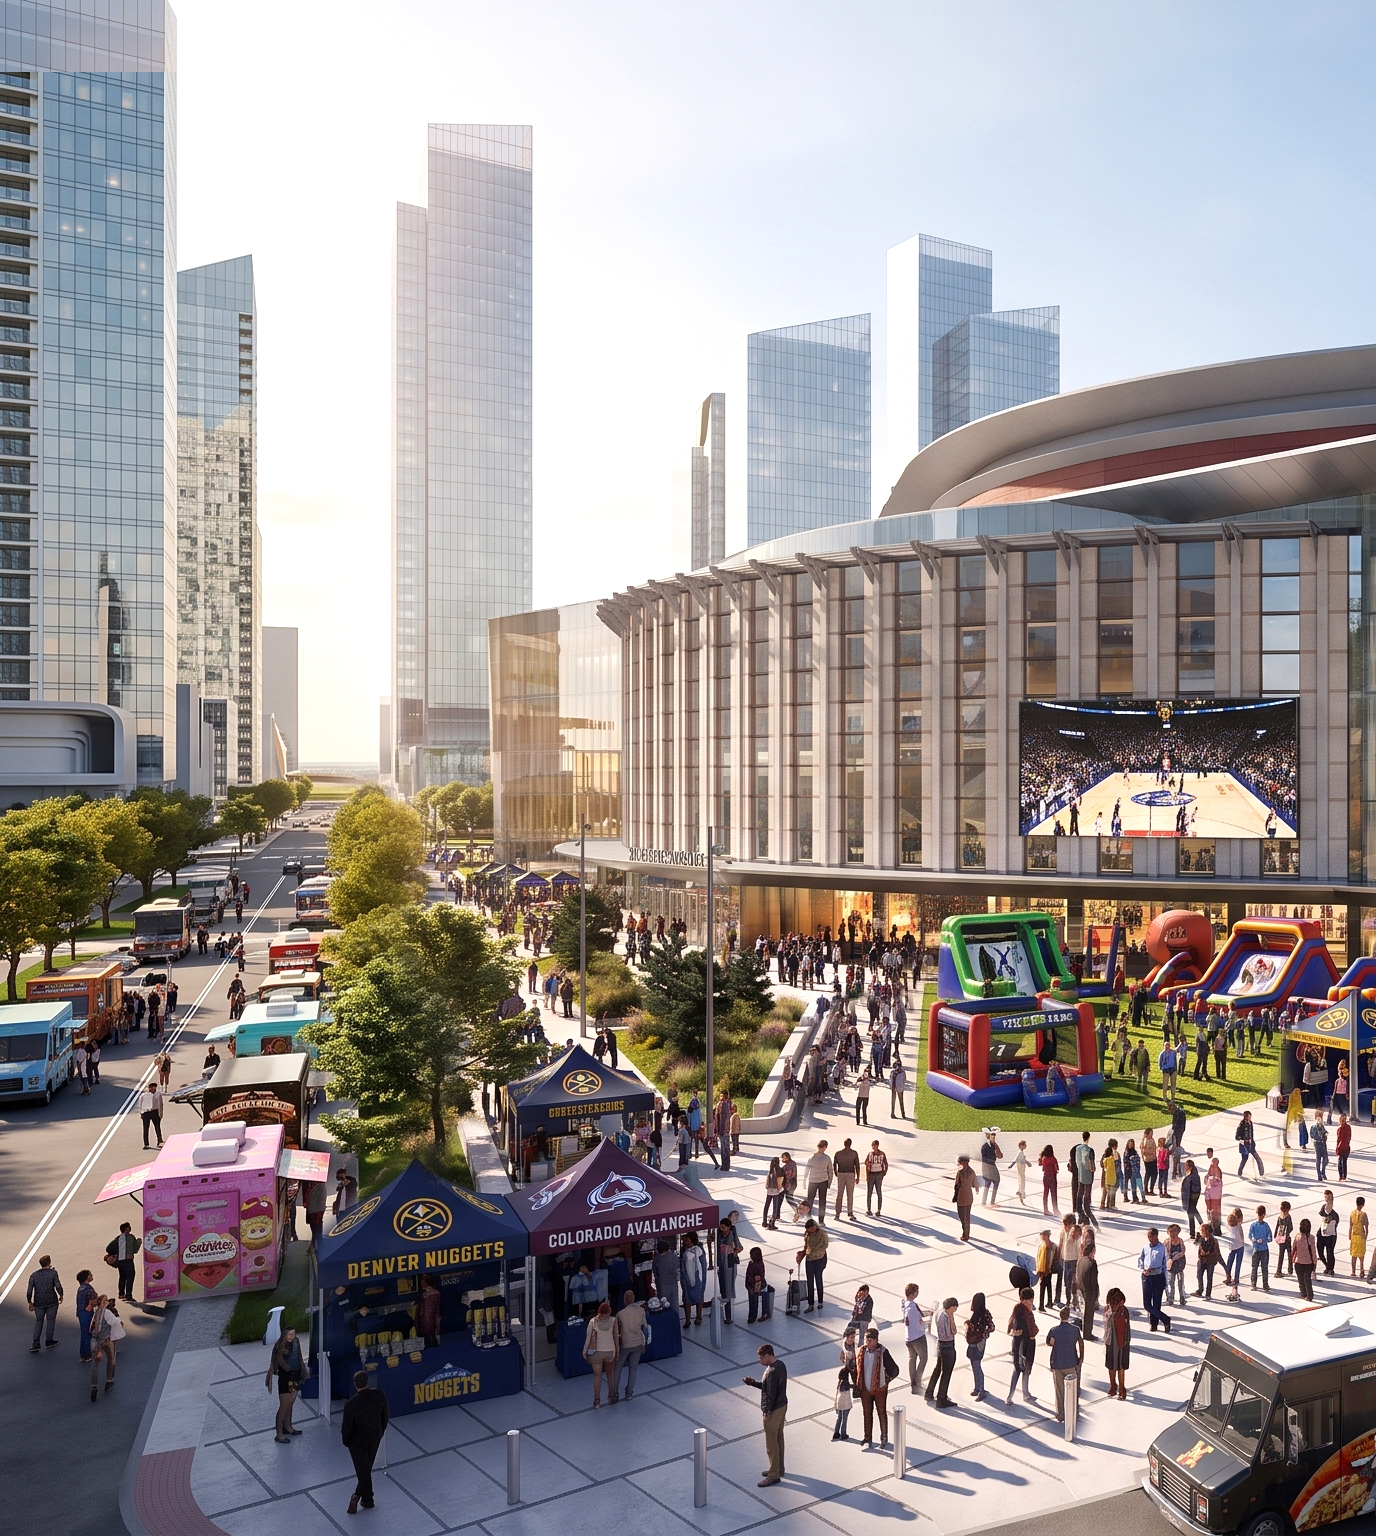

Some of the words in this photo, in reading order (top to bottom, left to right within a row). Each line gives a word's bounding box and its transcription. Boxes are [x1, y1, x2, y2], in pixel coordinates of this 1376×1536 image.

[548, 1224, 621, 1248] COLORADO
[626, 1212, 703, 1237] AVALANCHE
[347, 1254, 419, 1280] DENVER
[425, 1241, 505, 1268] NUGGETS
[413, 1373, 480, 1405] NUGGETS
